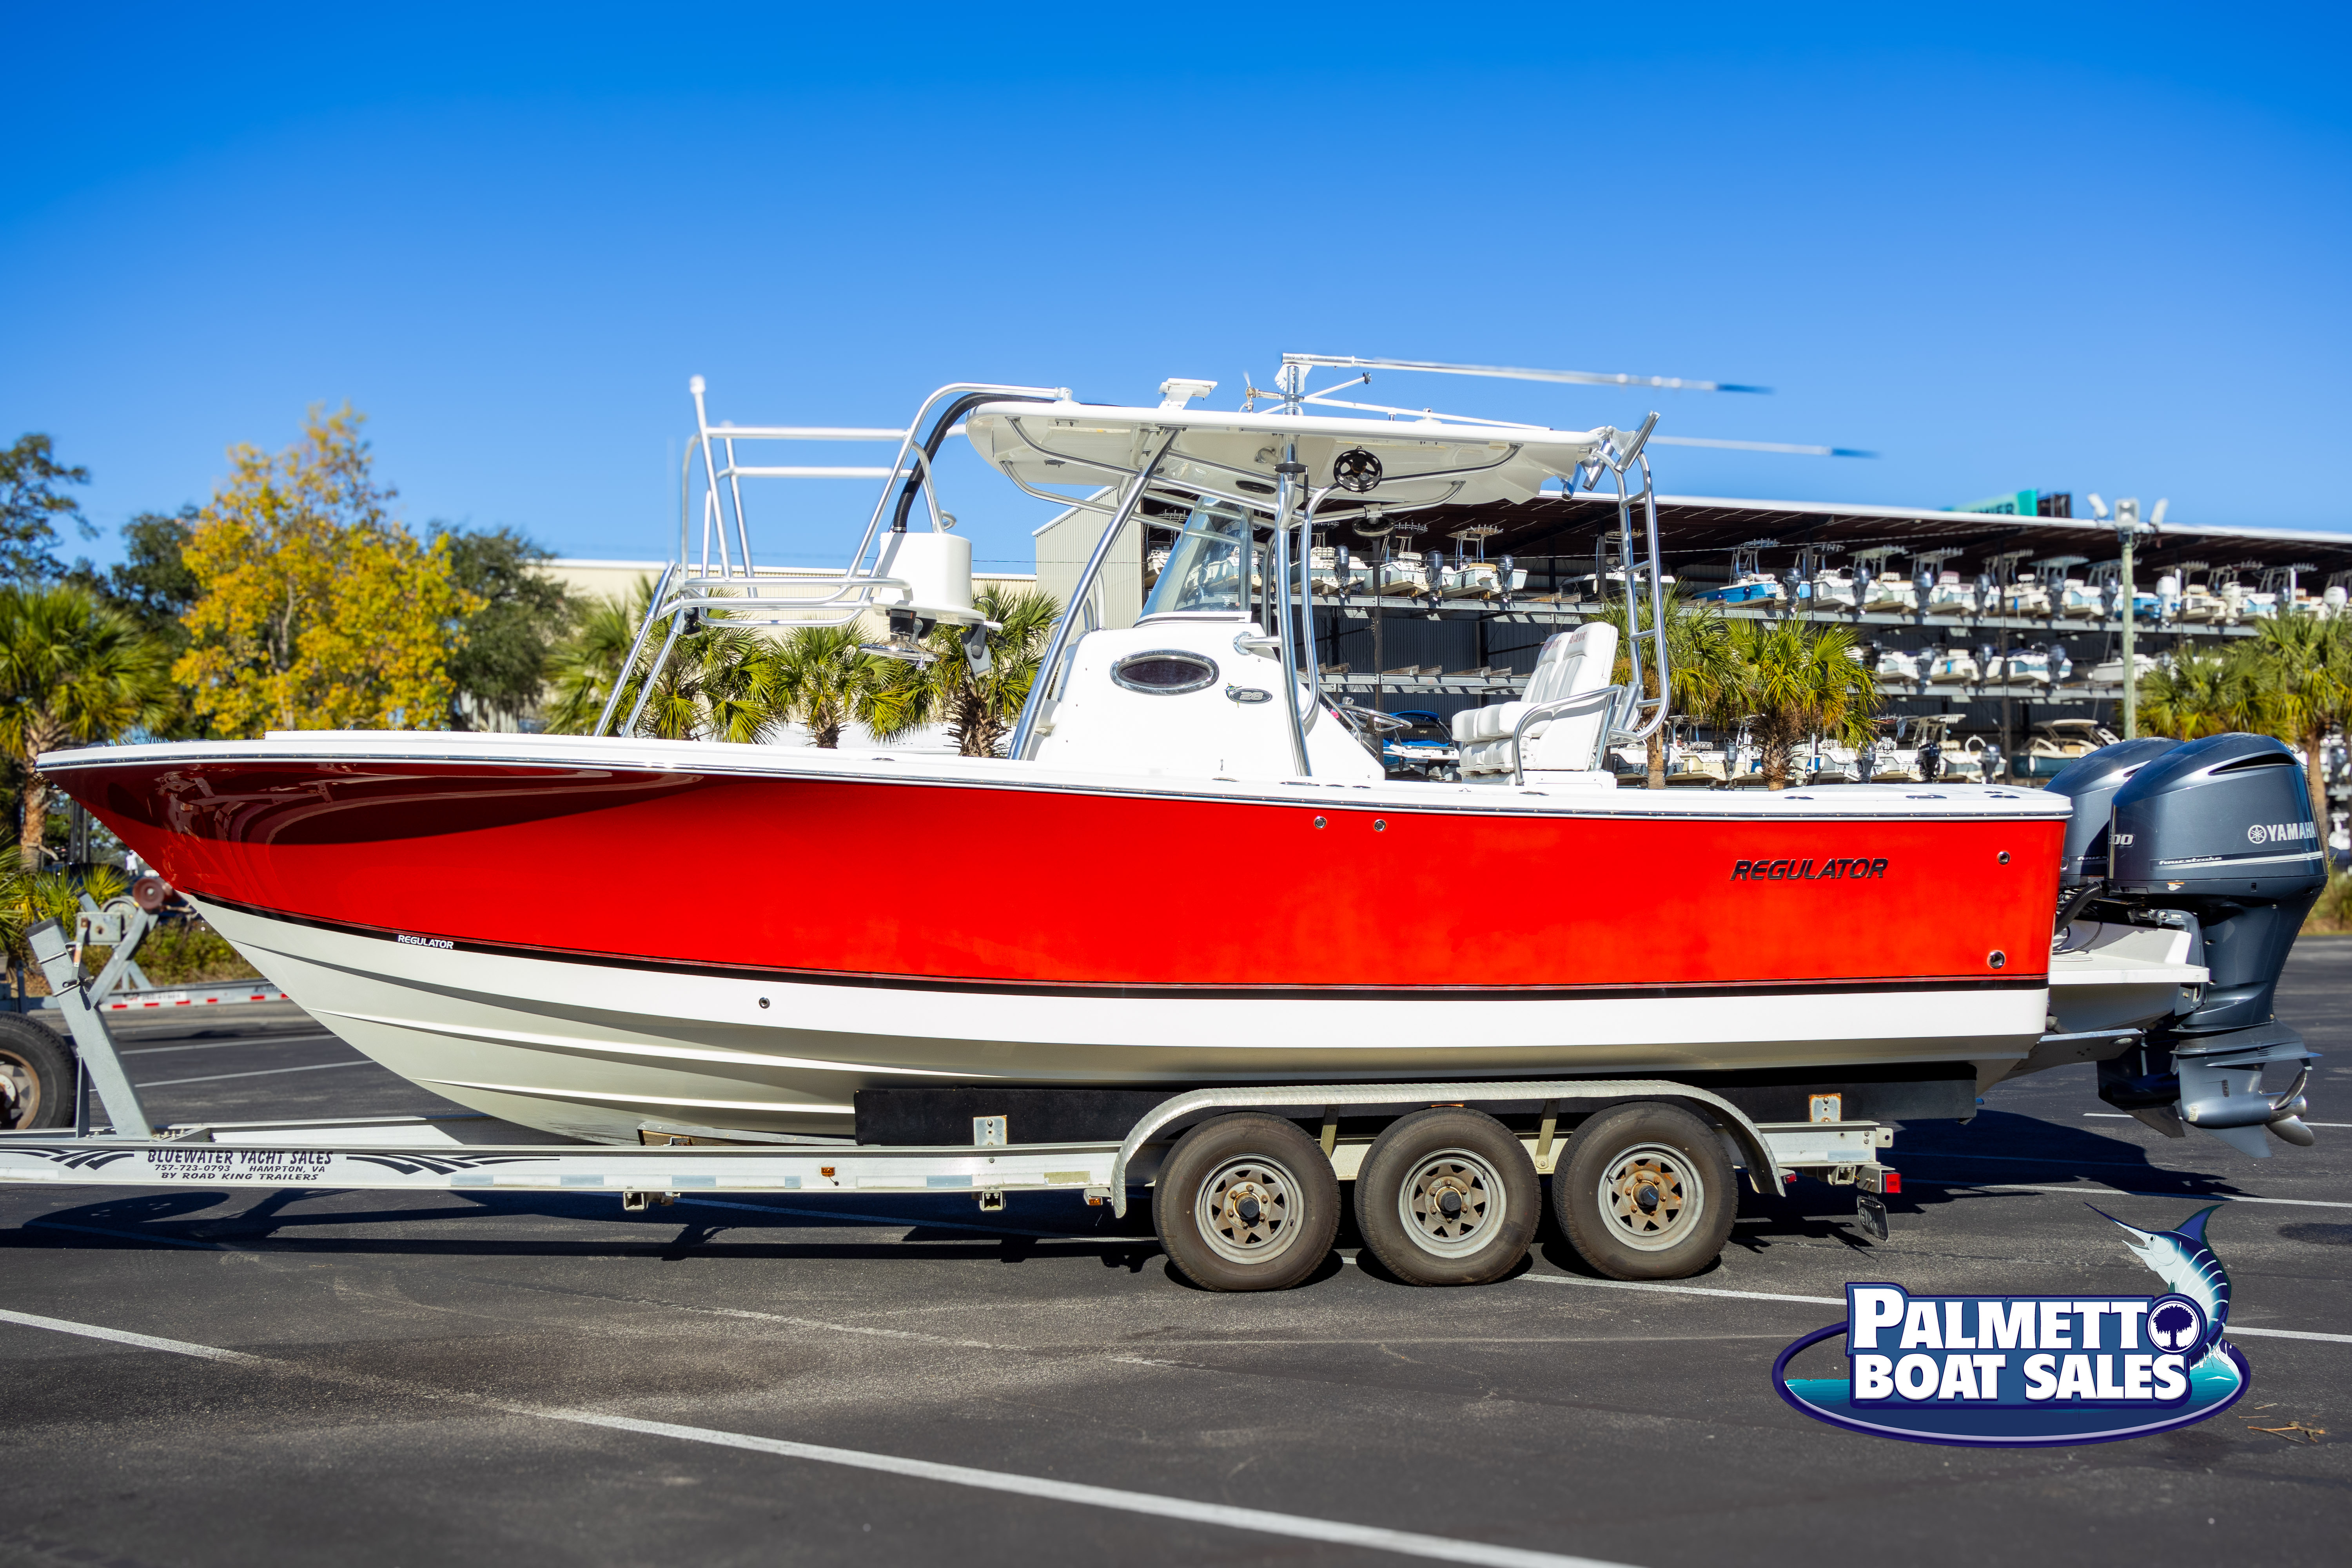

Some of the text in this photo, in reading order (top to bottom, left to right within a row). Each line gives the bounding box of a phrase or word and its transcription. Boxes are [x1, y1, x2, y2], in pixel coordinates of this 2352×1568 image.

[1240, 691, 1264, 700] 28
[2266, 822, 2316, 842] YAMAHA
[1730, 858, 1888, 880] REGULATOR
[398, 935, 454, 949] REGULATOR
[147, 1149, 333, 1164] BLUEWATER YACHT SALES
